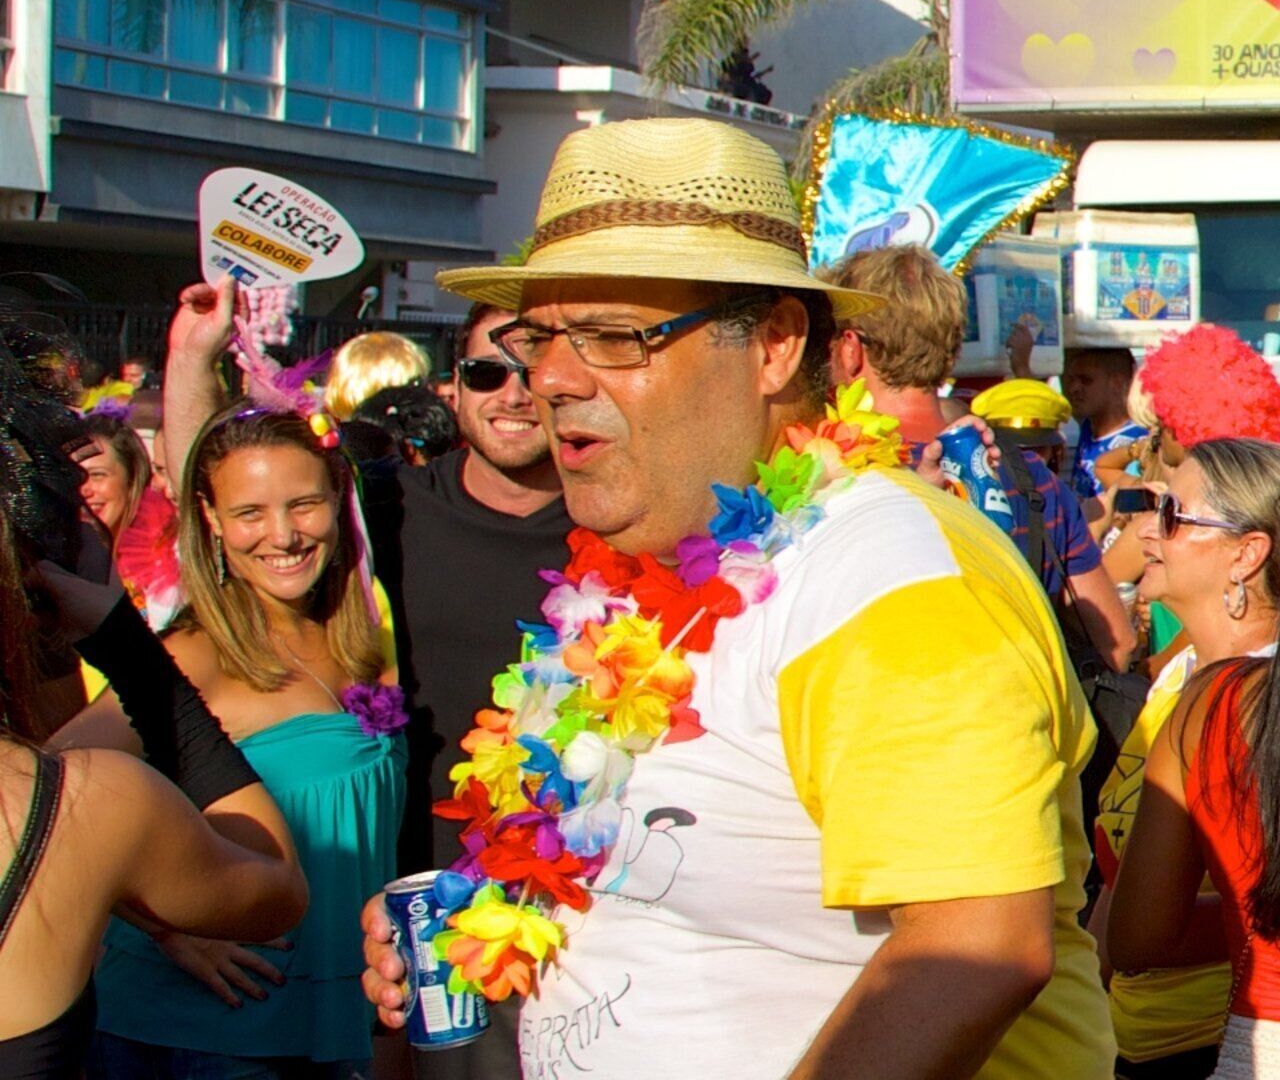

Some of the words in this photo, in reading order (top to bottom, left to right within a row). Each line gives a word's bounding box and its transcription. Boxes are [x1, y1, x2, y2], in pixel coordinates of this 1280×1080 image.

[1212, 44, 1234, 62] 30
[232, 181, 284, 220] LEI
[272, 206, 344, 258] SECA
[279, 184, 338, 223] OPERAÇÃO
[217, 223, 308, 270] COLABORE
